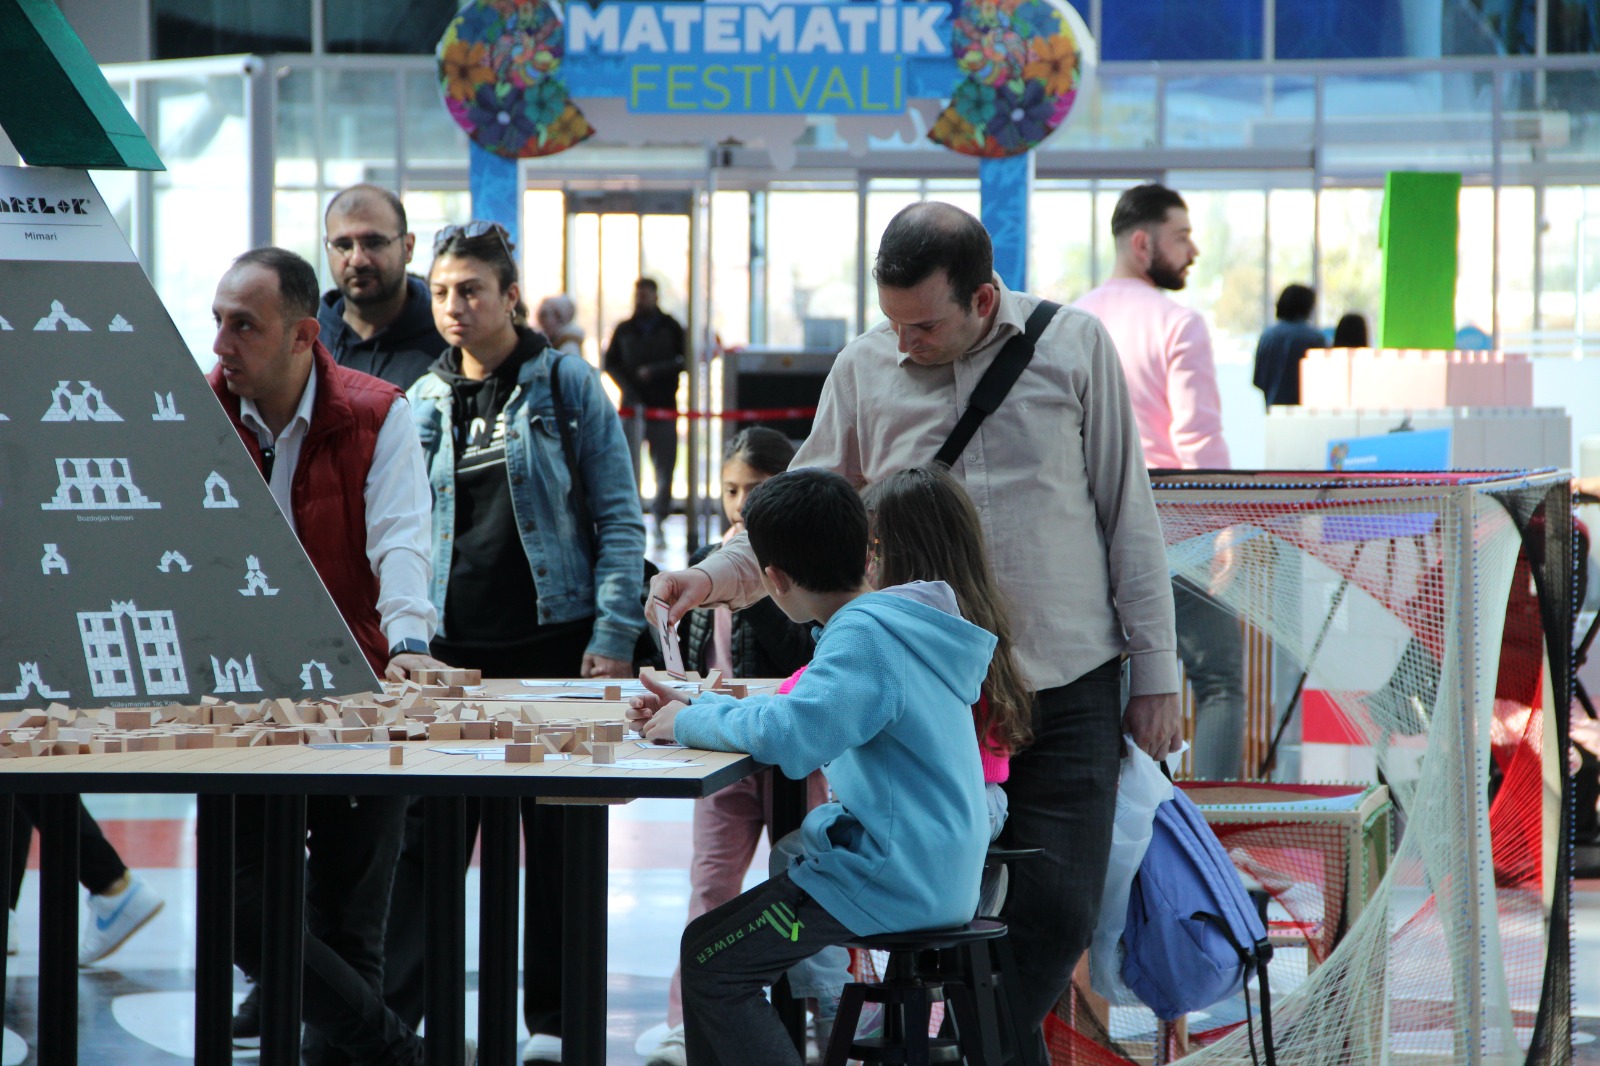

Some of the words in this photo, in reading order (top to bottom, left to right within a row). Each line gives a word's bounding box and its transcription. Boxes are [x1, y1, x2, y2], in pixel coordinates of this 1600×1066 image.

[568, 0, 947, 54] MATEMATİK
[630, 54, 903, 111] FESTİVALİ
[25, 232, 58, 240] Mimari
[748, 915, 767, 933] MY
[697, 929, 744, 963] POWER
